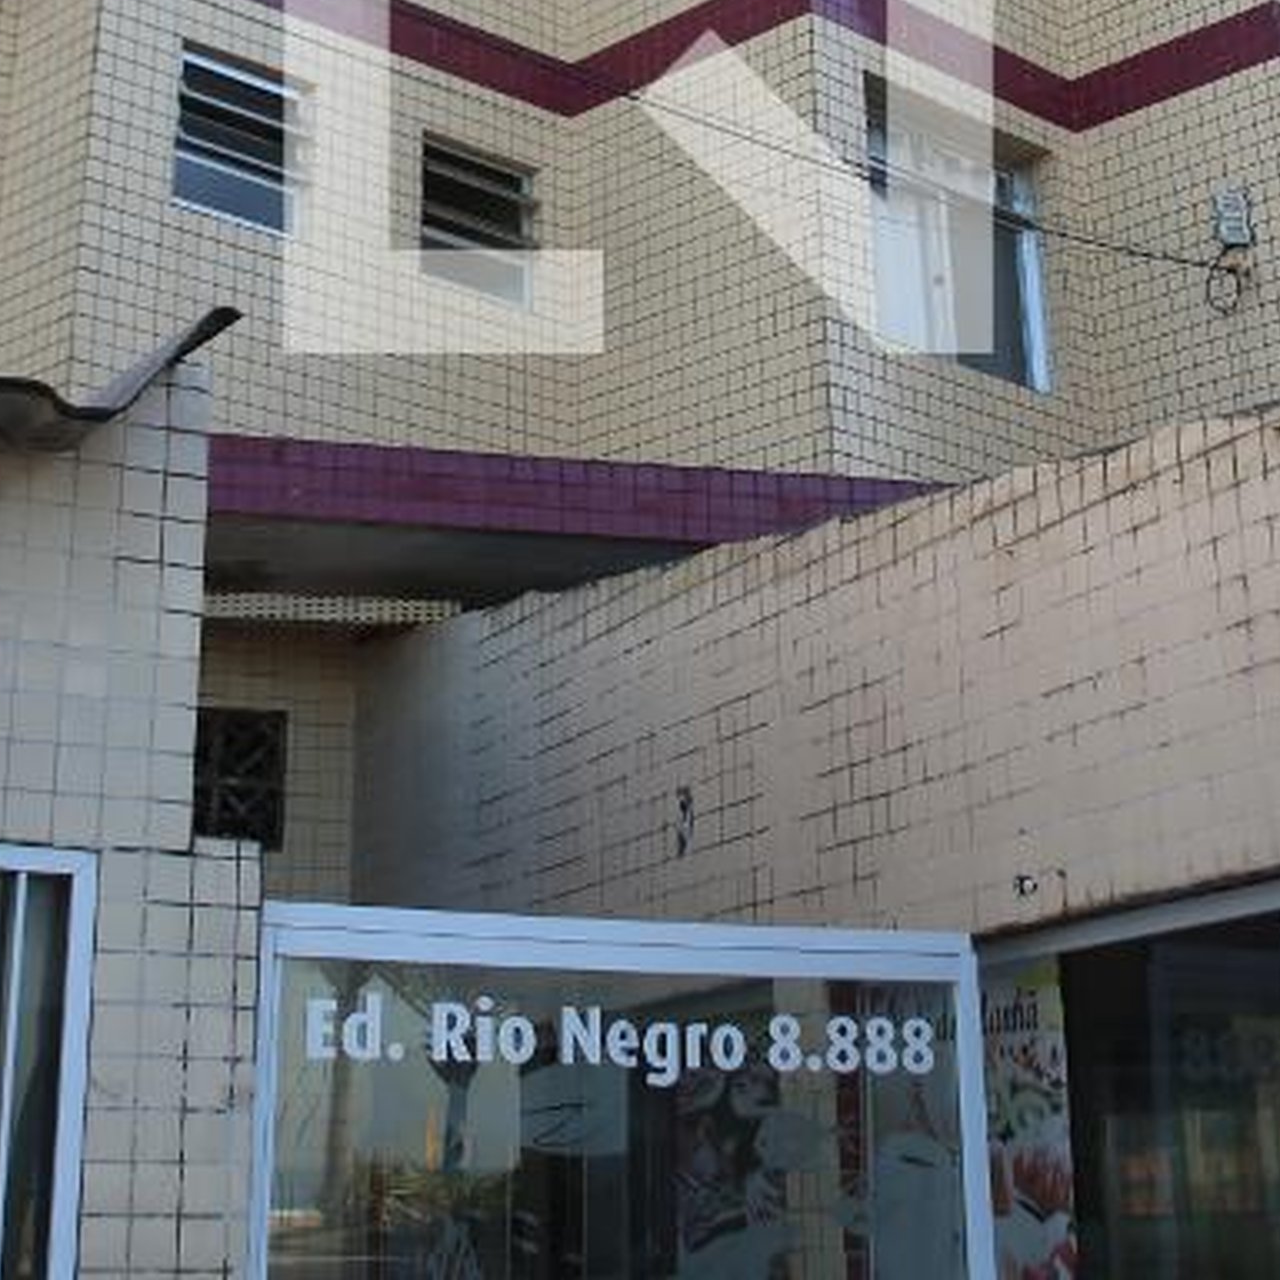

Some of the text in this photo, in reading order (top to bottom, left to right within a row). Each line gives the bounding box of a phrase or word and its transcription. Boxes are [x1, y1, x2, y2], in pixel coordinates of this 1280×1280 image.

[304, 992, 935, 1088] Ed. Rio Negro 8.888
